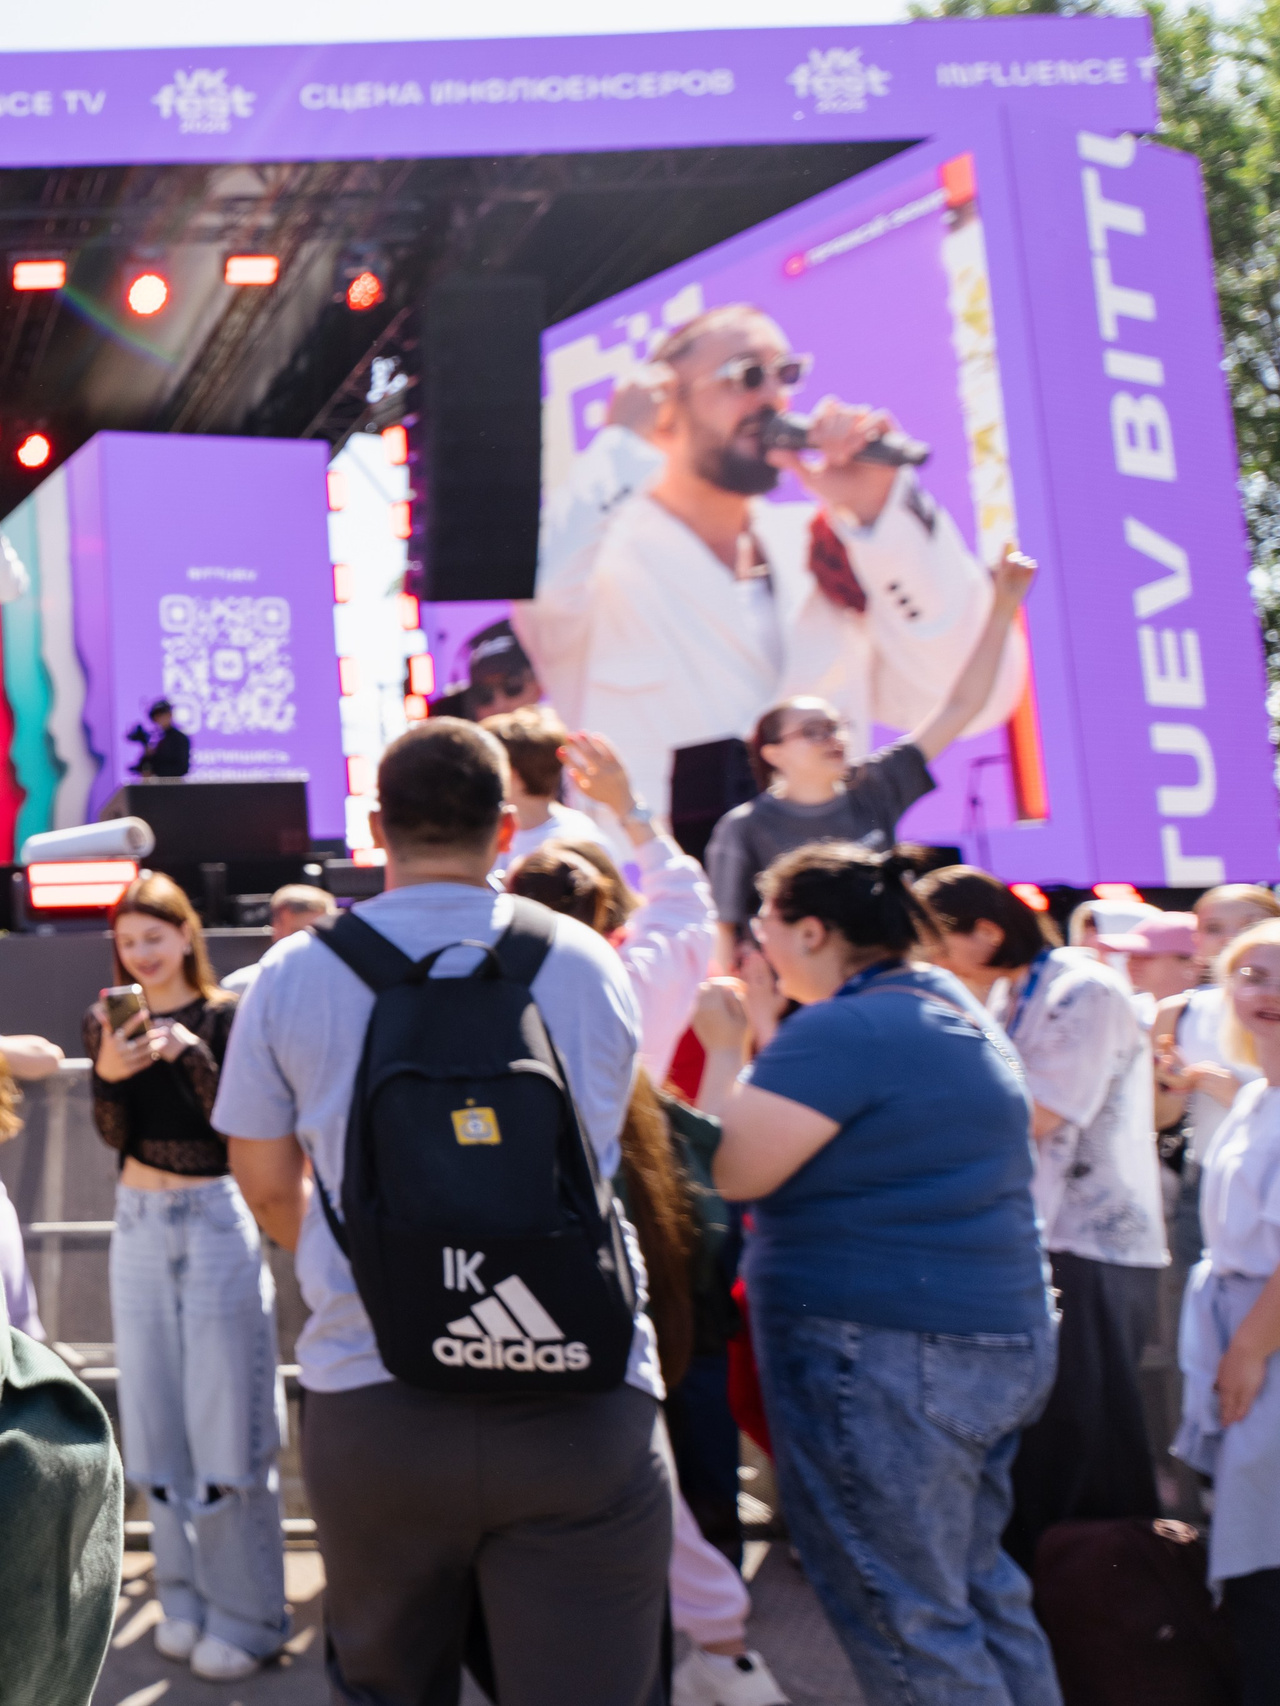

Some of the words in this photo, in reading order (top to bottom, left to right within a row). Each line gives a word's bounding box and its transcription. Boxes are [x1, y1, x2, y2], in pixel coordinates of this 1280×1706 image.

[808, 46, 864, 73] VK
[935, 57, 1128, 88] INFLUENCE
[174, 68, 228, 94] VK
[298, 81, 425, 114] СЦЕНА
[429, 68, 735, 107] ИНФЛЮЕНСЕРОВ
[61, 89, 107, 115] TV
[432, 1336, 591, 1373] adidas
